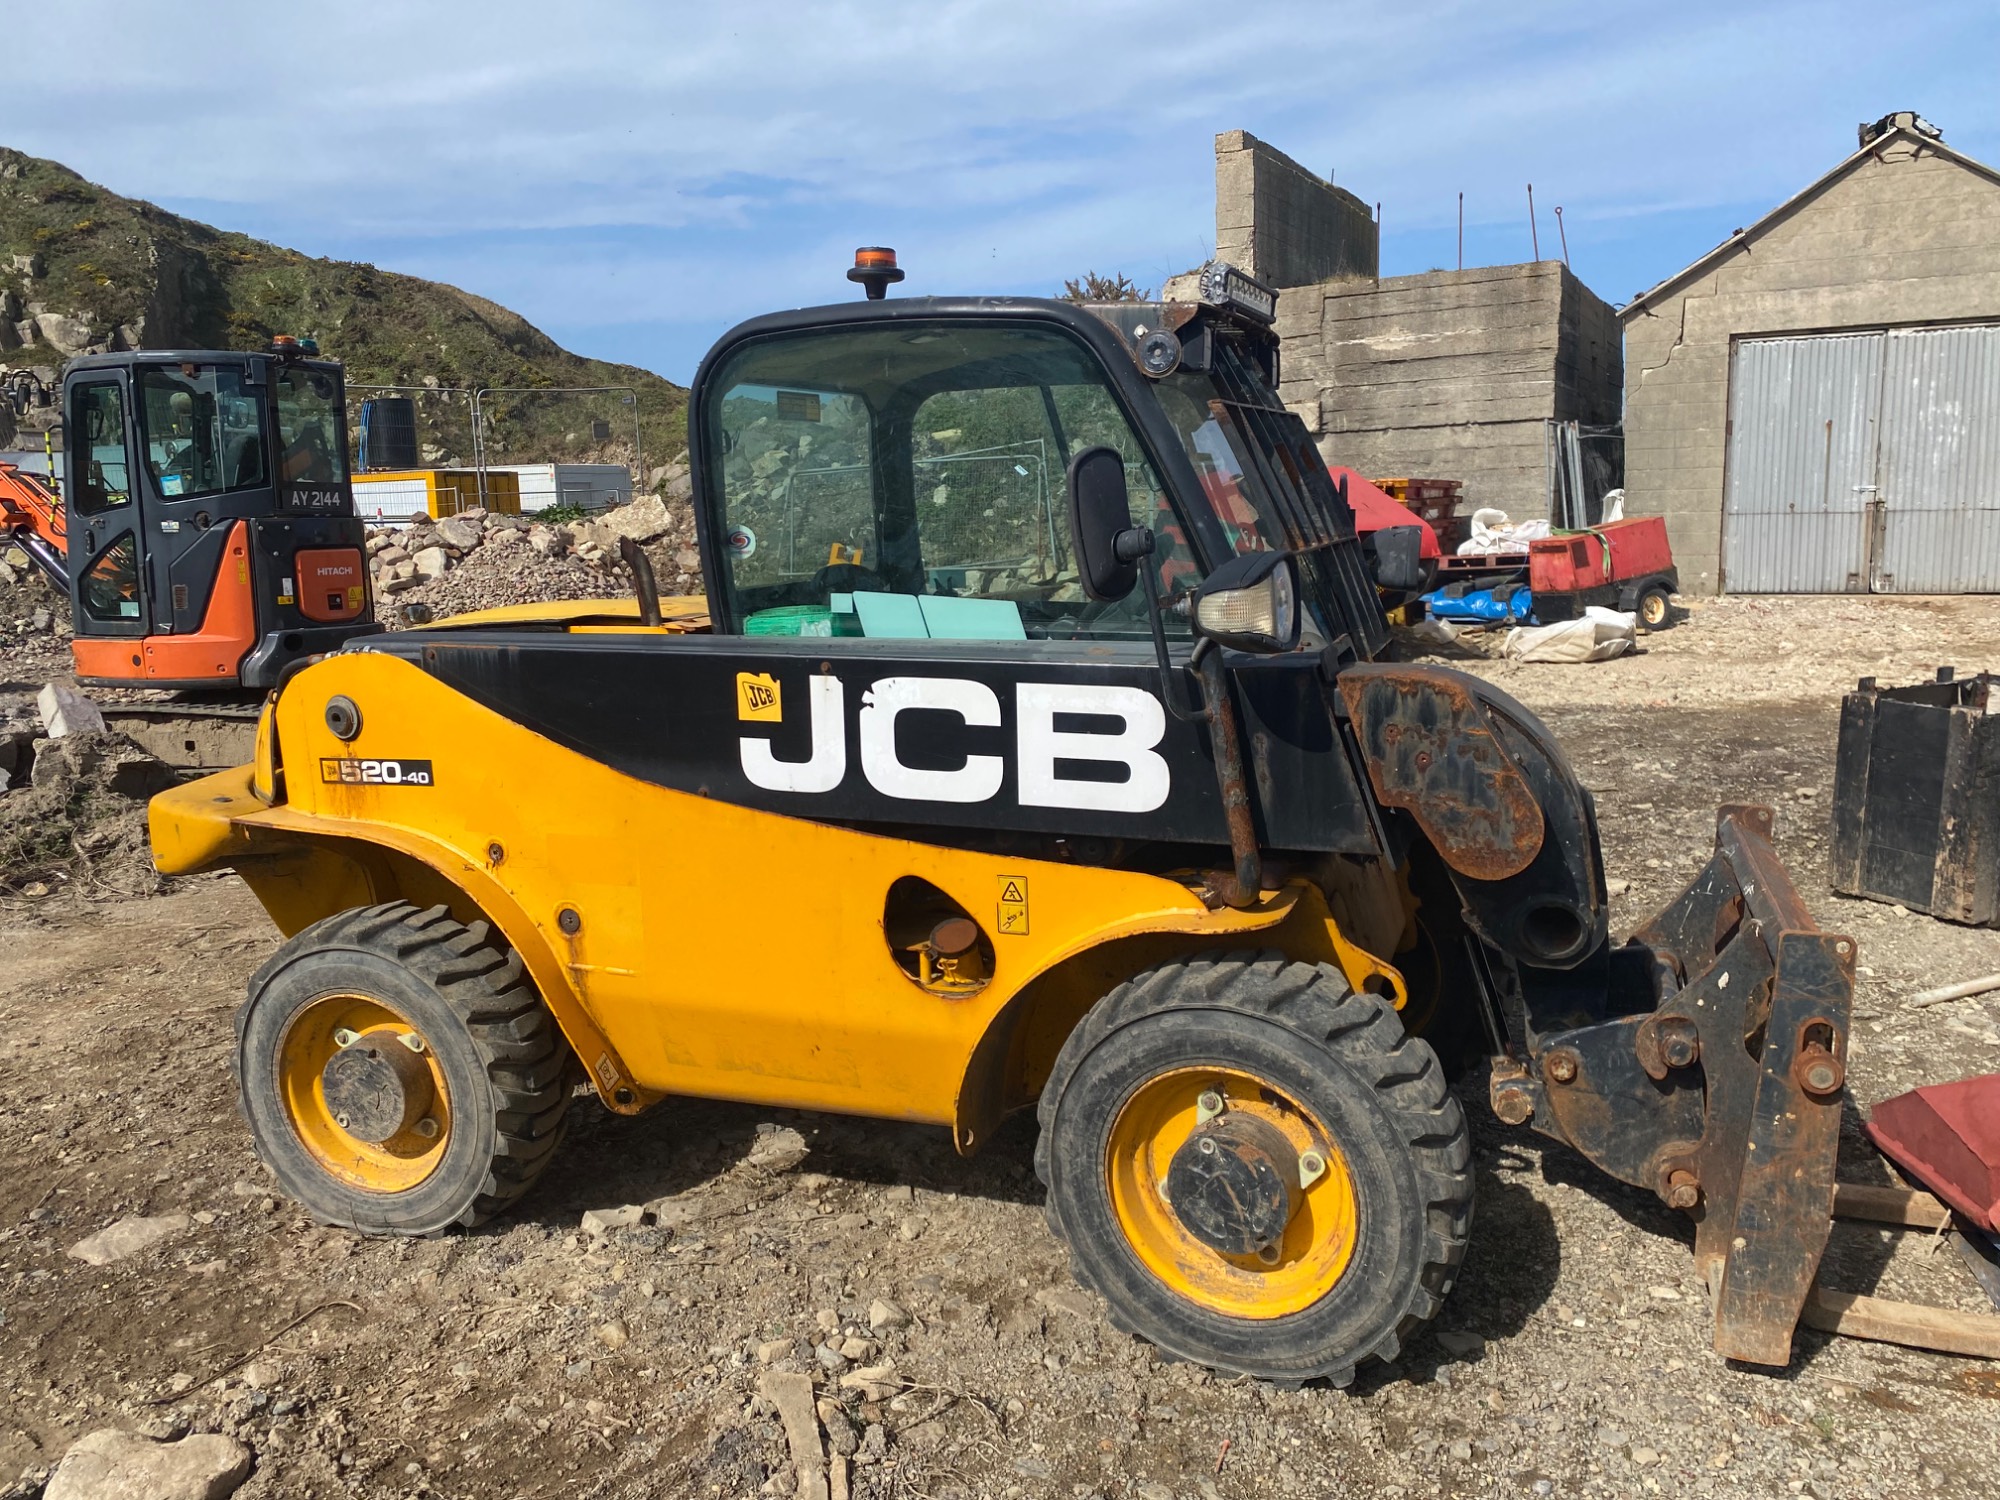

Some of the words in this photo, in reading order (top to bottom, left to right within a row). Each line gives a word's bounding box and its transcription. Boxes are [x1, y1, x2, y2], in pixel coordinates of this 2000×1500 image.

[292, 490, 308, 506] AY
[311, 491, 341, 506] 2144
[317, 566, 353, 576] HITACHI
[748, 684, 774, 708] JCB
[738, 674, 1170, 812] JCB
